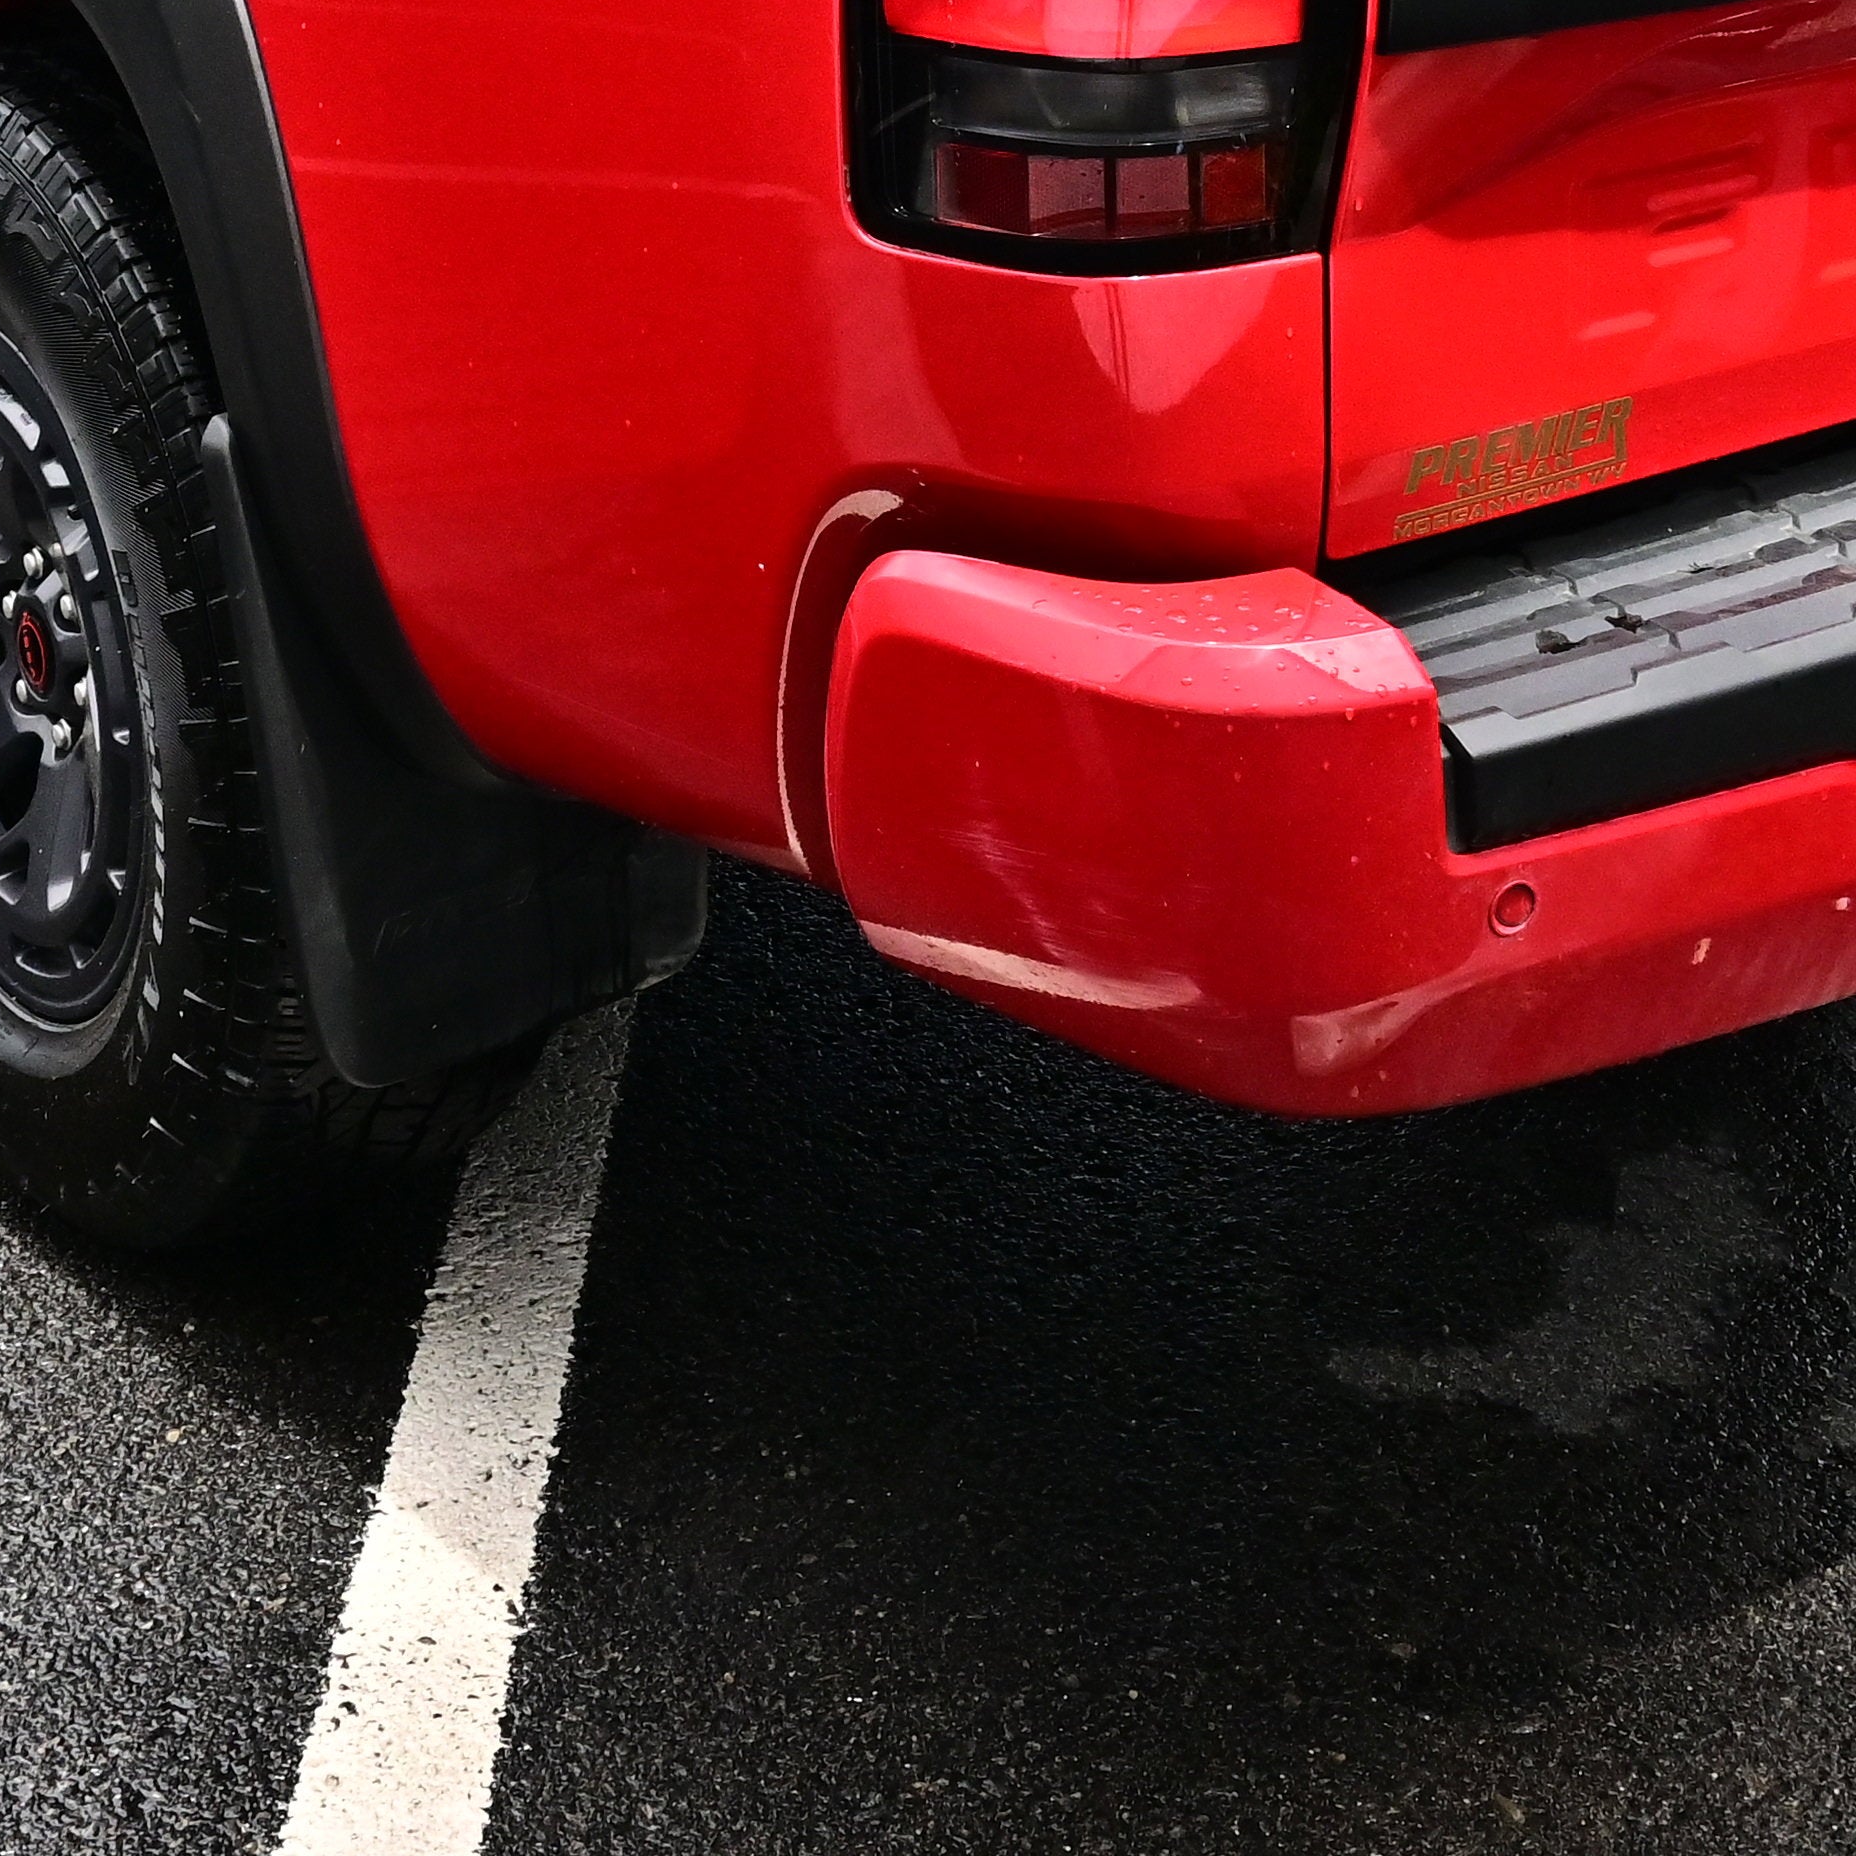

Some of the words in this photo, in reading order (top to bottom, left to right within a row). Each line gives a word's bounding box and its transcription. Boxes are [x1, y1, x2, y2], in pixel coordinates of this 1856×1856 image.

[1403, 395, 1633, 494] PREMIER
[1456, 452, 1574, 498] NISSAN
[1394, 476, 1580, 540] MORGANTOWN
[1588, 462, 1627, 486] WV
